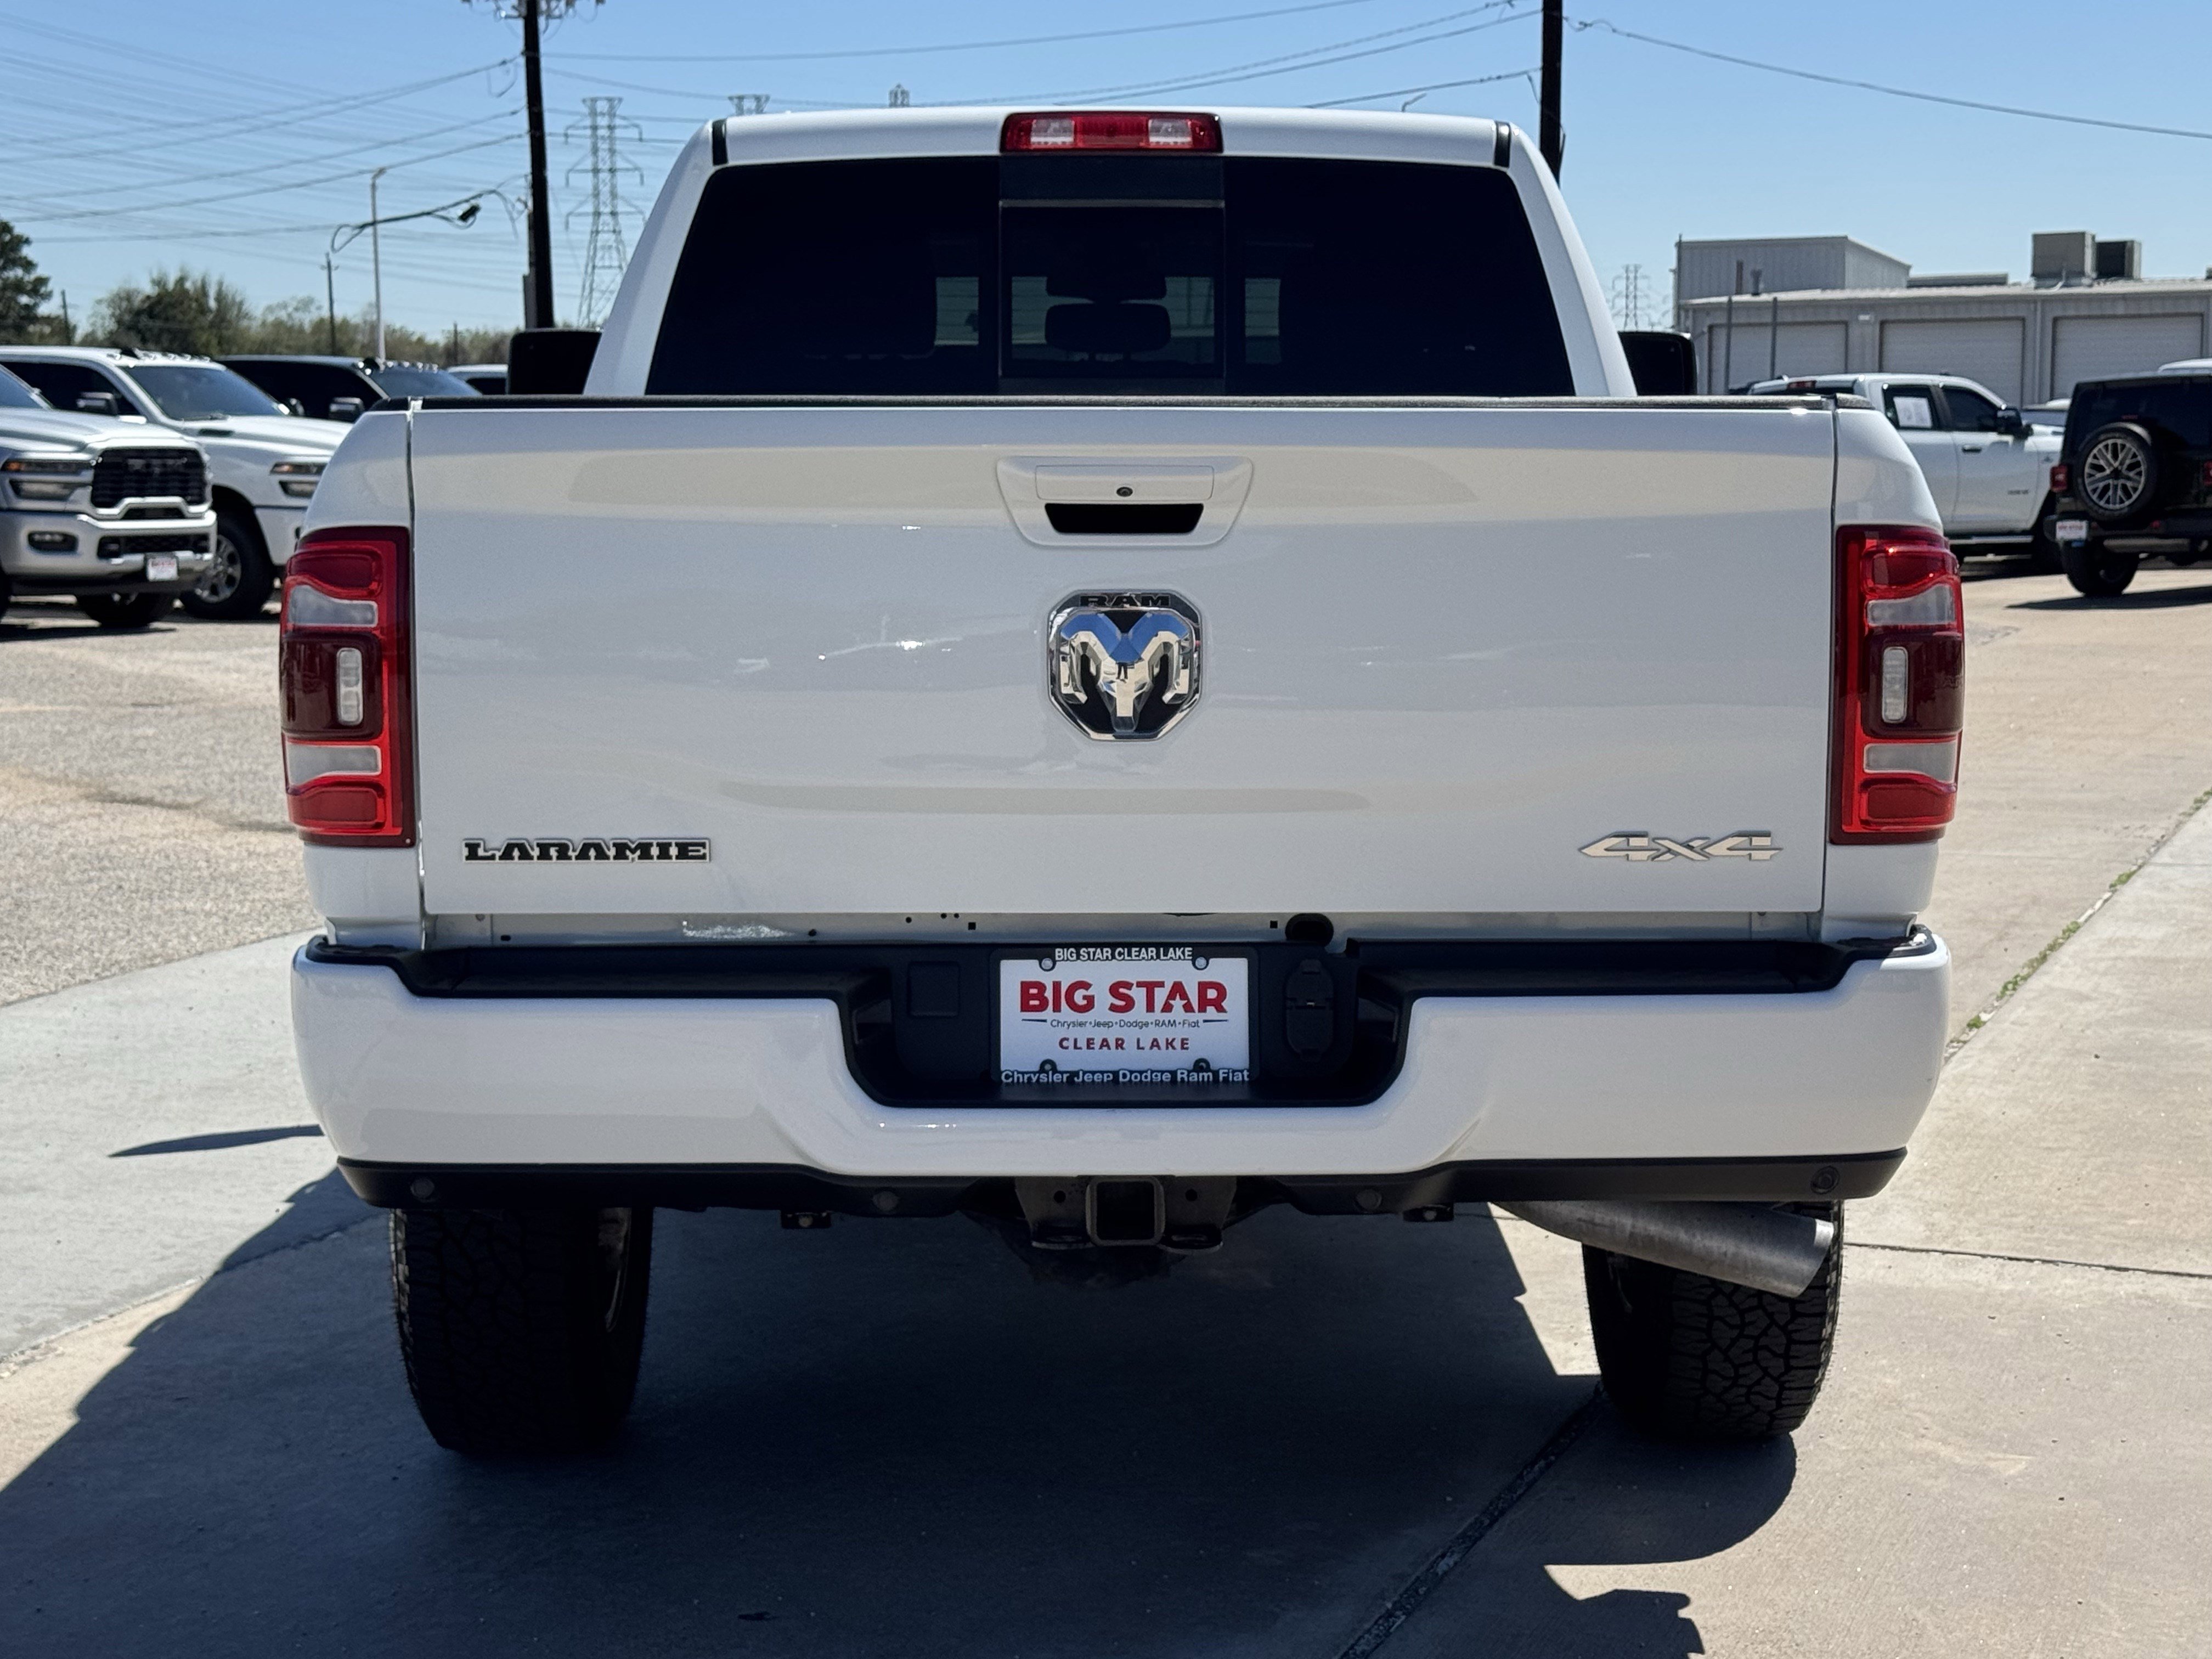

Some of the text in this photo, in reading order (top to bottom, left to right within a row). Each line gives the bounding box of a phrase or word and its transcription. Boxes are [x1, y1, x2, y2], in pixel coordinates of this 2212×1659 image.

[1079, 595, 1171, 607] RAM
[464, 838, 711, 863] LARAMIE
[1055, 947, 1193, 961] BIG STAR CLEAR LAKE
[1020, 980, 1228, 1014] BIG STAR
[1058, 1037, 1190, 1051] CLEAR LAKE
[1001, 1069, 1250, 1083] Chrysler Jeep Dodge Ram Fiat
